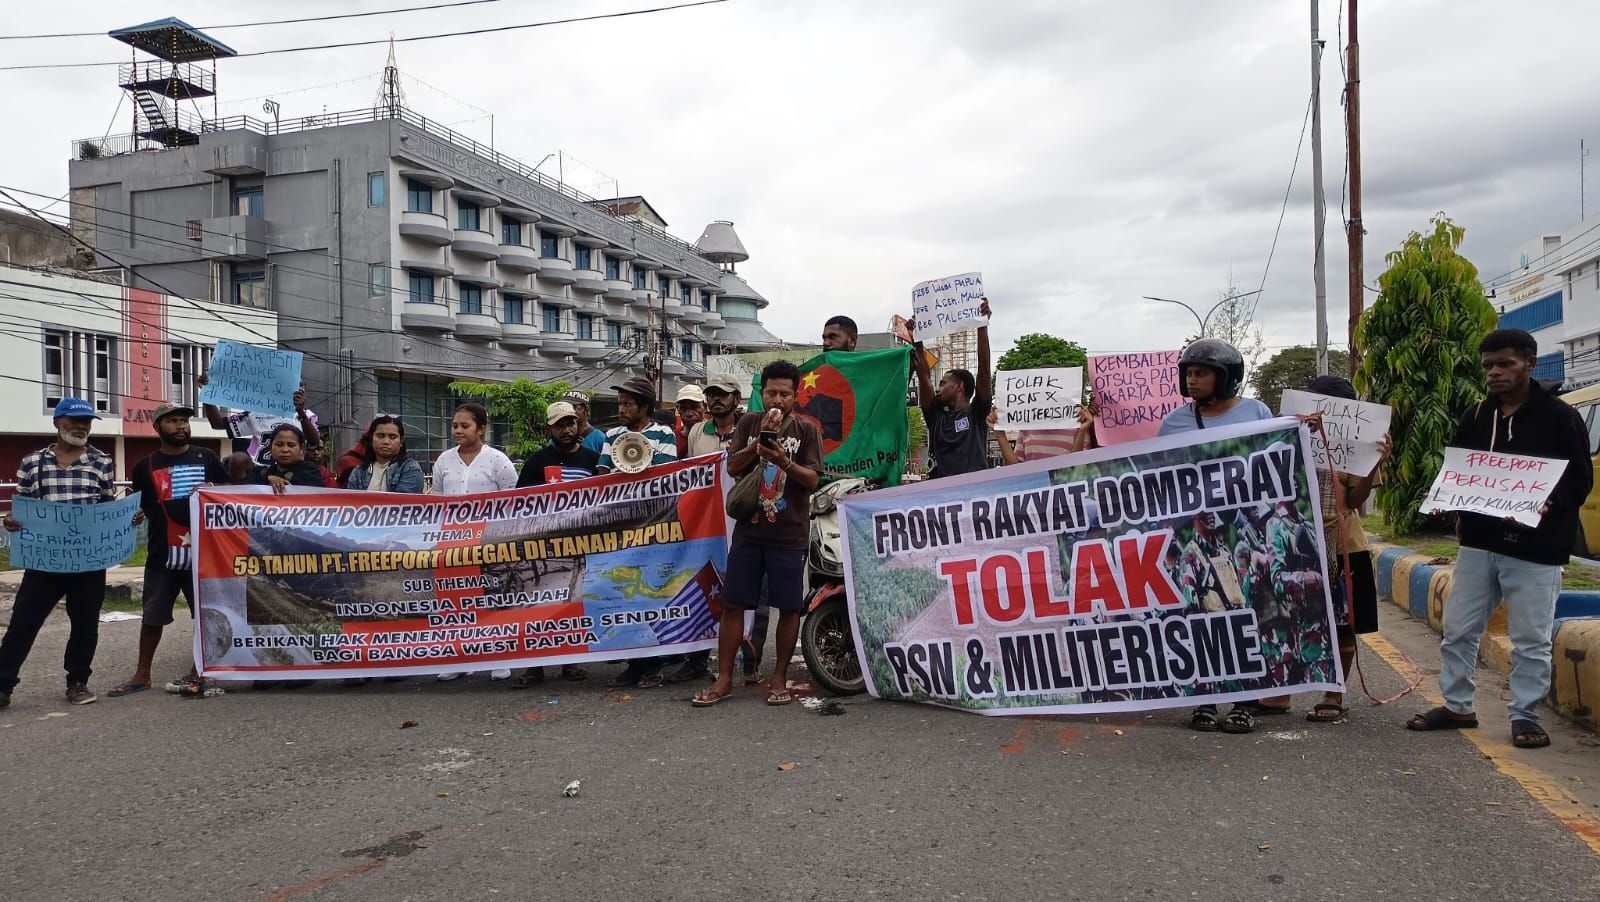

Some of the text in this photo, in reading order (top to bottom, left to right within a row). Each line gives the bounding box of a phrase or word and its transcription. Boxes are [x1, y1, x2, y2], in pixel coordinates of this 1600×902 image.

[1005, 375, 1063, 390] TOLAK
[1150, 366, 1179, 385] PAP
[1007, 392, 1038, 408] PSN
[1159, 383, 1178, 398] DA
[123, 408, 156, 422] JAW
[1312, 398, 1372, 424] TOLAK
[1466, 452, 1549, 473] FREEPORT
[1441, 470, 1550, 494] PERUSAK
[204, 463, 715, 530] FRONT RAKYAT DOMBERAI TOLAK PSN DAN MILITERISME
[874, 448, 1296, 554] FRONT RAKYAT DOMBERAY
[19, 499, 83, 524] TUTUP
[233, 555, 260, 576] 59
[261, 554, 319, 575] TAHUN
[319, 551, 347, 574] PT.
[348, 548, 443, 573] FREEPORT
[444, 541, 521, 568] ILLEGAL
[523, 538, 548, 561] DI
[549, 530, 619, 559] TANAH
[621, 520, 685, 550] PAPUA
[422, 528, 473, 544] THEMA
[20, 541, 123, 559] MENENTUKAN
[403, 579, 433, 593] SUB
[436, 575, 490, 591] THEMA
[941, 534, 1180, 626] TOLAK
[336, 587, 570, 617] INDONESIA PENJAJAH
[233, 605, 691, 649] BERIKAN HAK MENENTUKAN NASIB SENDIRI
[428, 613, 477, 628] DAN
[313, 631, 600, 663] BAGI BANGSA WEST PAPUA
[885, 615, 1263, 697] PSN & MILITERISME
